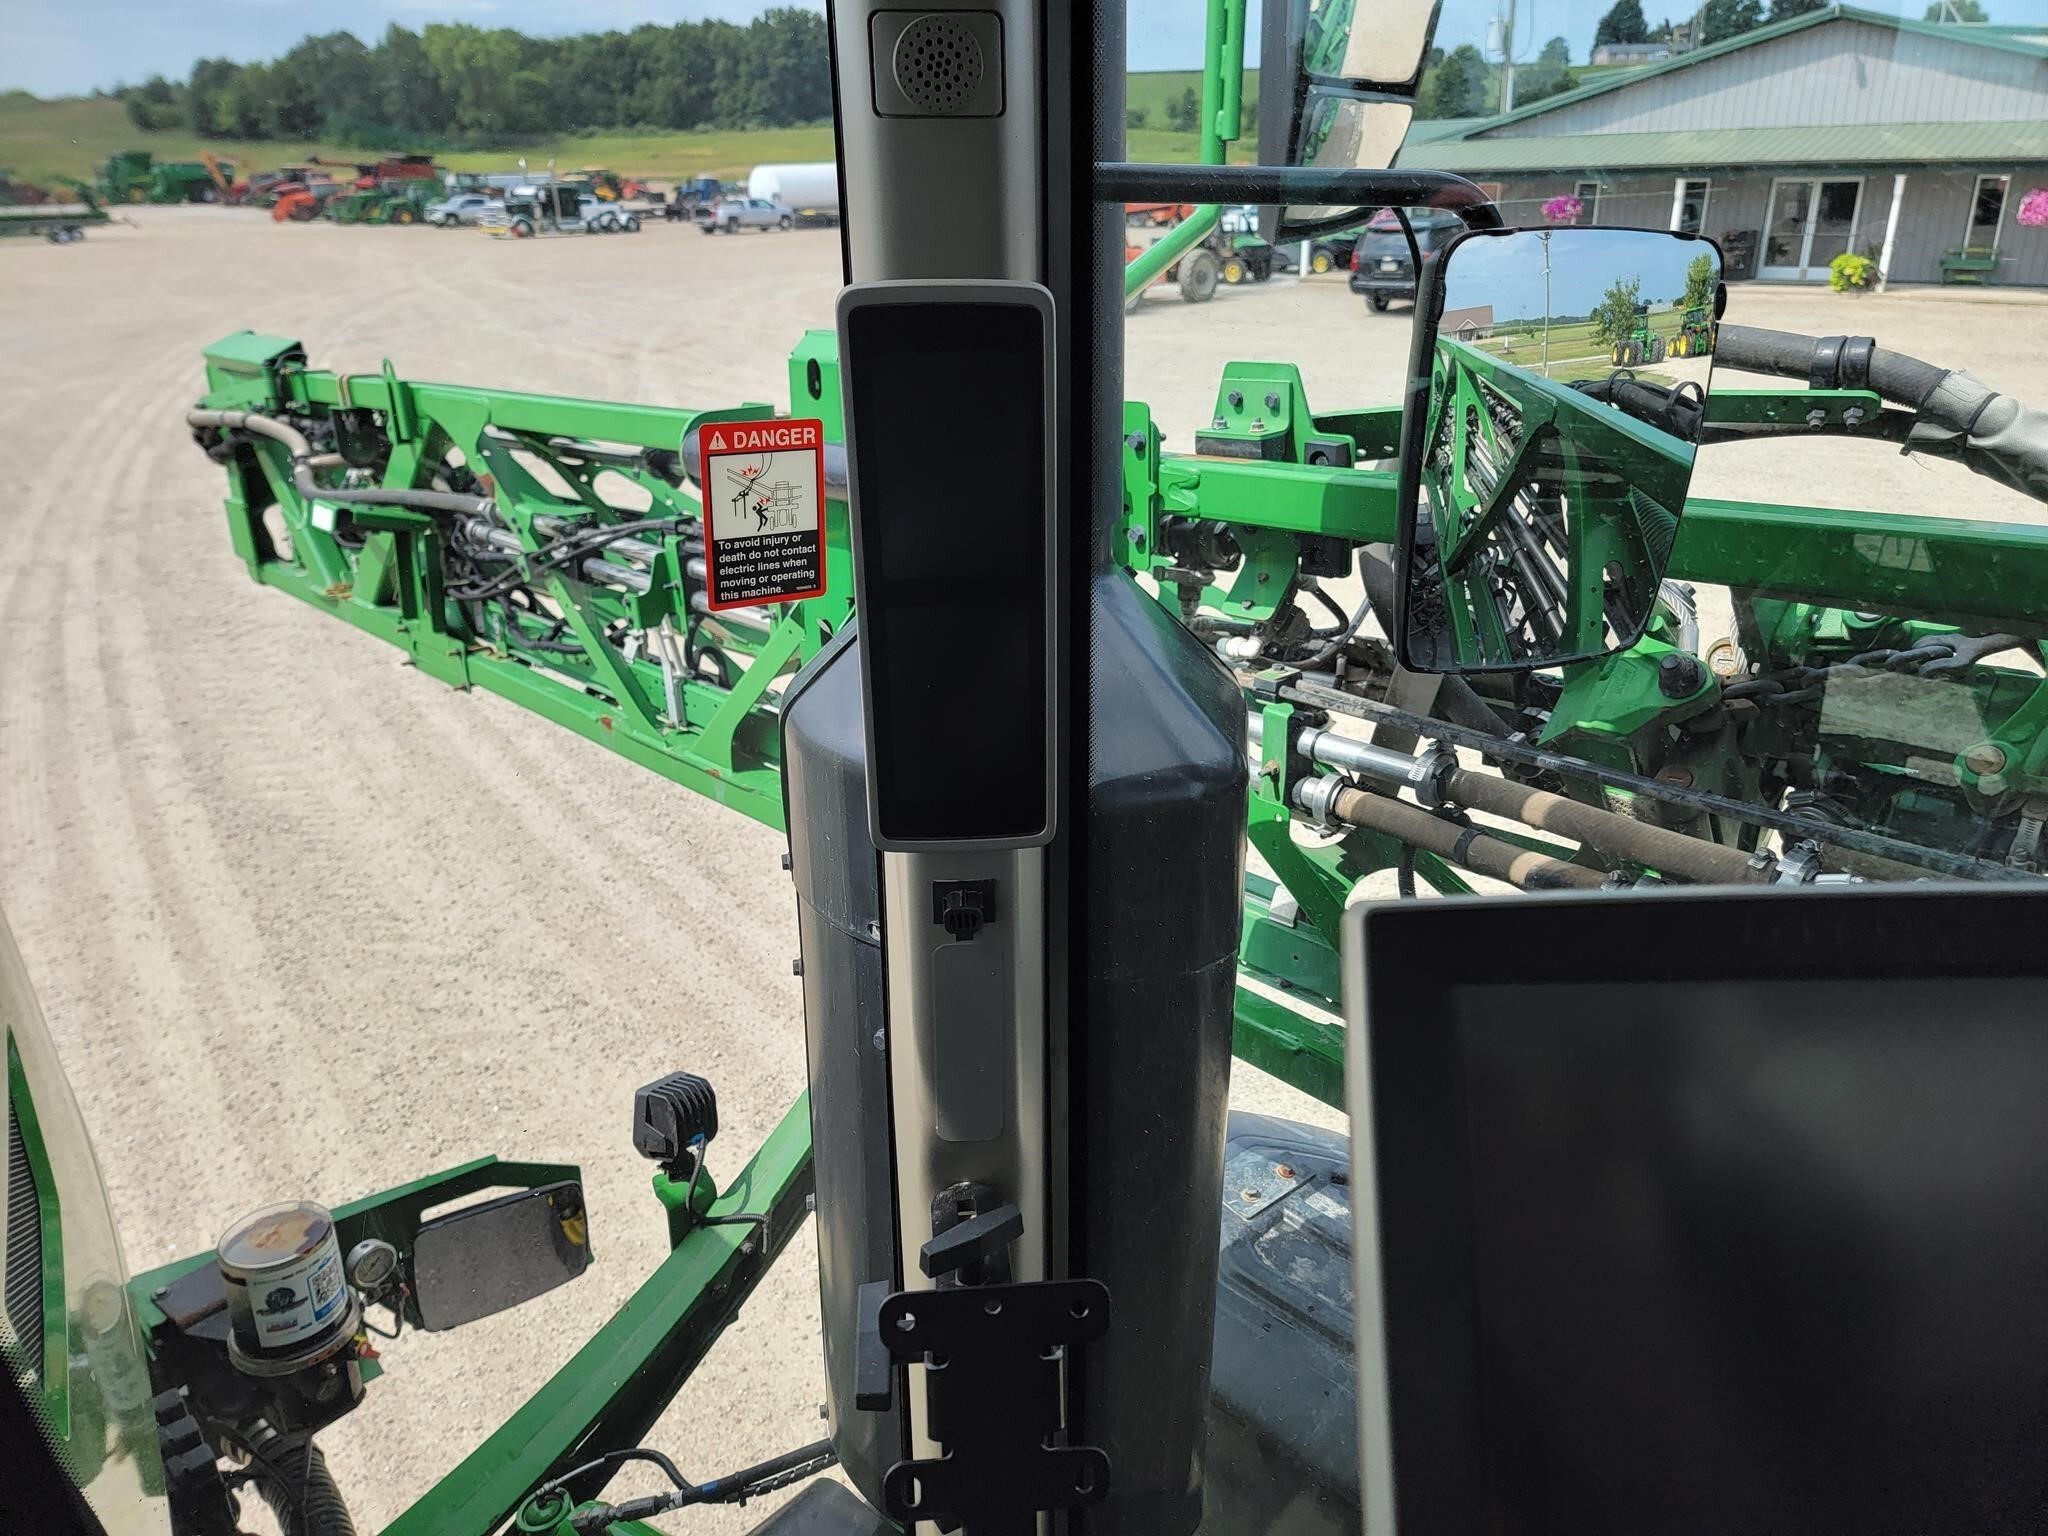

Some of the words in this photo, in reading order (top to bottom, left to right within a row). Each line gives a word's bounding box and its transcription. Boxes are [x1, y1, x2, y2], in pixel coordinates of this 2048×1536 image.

[733, 427, 816, 449] DANGER
[718, 541, 731, 550] To
[734, 537, 760, 549] avoid
[762, 536, 789, 547] injury
[792, 534, 802, 542] or
[719, 552, 746, 563] death
[749, 550, 761, 560] do
[764, 548, 779, 558] not
[781, 544, 816, 556] contact
[719, 563, 755, 576] electric
[757, 561, 780, 571] lines
[782, 558, 807, 568] when
[720, 576, 756, 588] moving
[759, 575, 769, 583] or
[771, 569, 815, 583] operating
[720, 590, 739, 600] this
[741, 586, 784, 598] machine.
